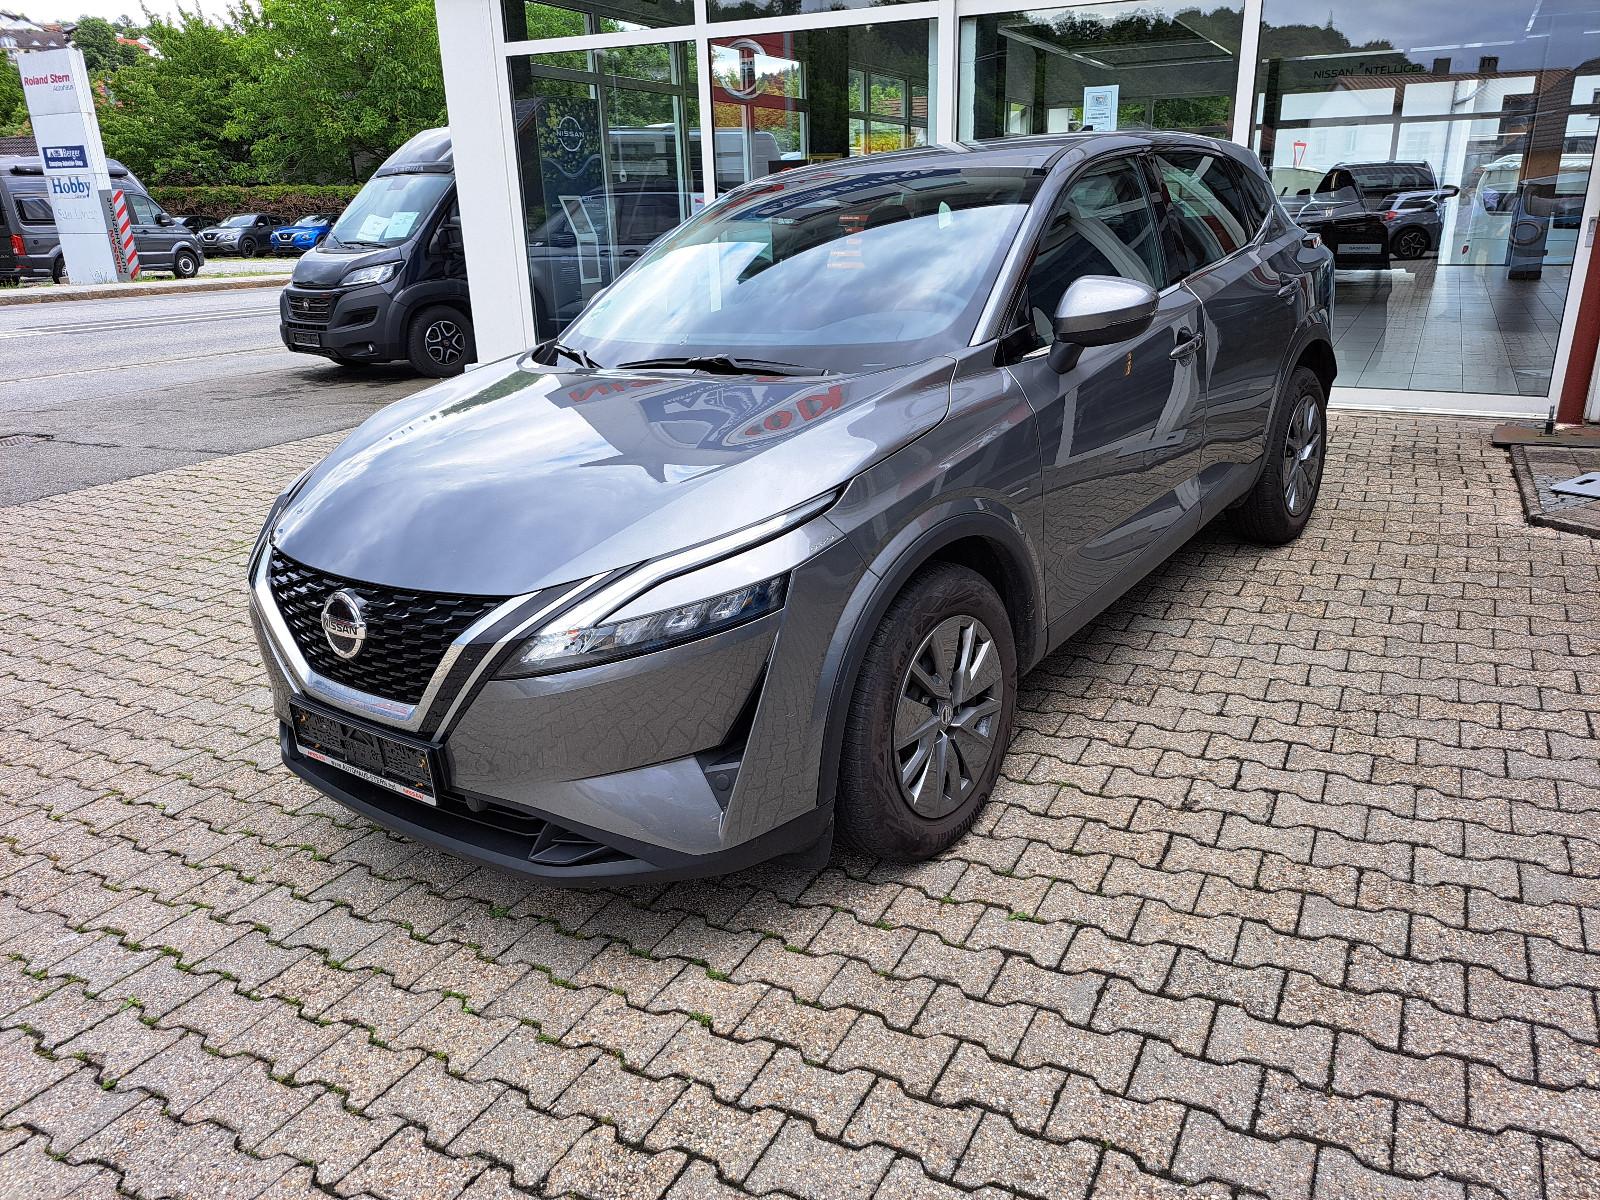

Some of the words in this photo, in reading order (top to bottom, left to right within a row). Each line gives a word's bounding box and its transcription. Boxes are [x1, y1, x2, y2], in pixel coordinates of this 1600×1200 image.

[24, 74, 49, 87] Roland
[50, 73, 70, 84] Stern
[1313, 68, 1354, 79] NISSAN
[556, 130, 585, 138] NISSAN
[62, 148, 81, 160] Berger
[52, 176, 91, 198] Hobby
[106, 197, 128, 274] NUTZFAHRZEUGE
[108, 229, 123, 274] NISSAN
[323, 617, 358, 636] NISSAN
[307, 750, 326, 761] NISSAN
[402, 787, 424, 800] NISSAN
